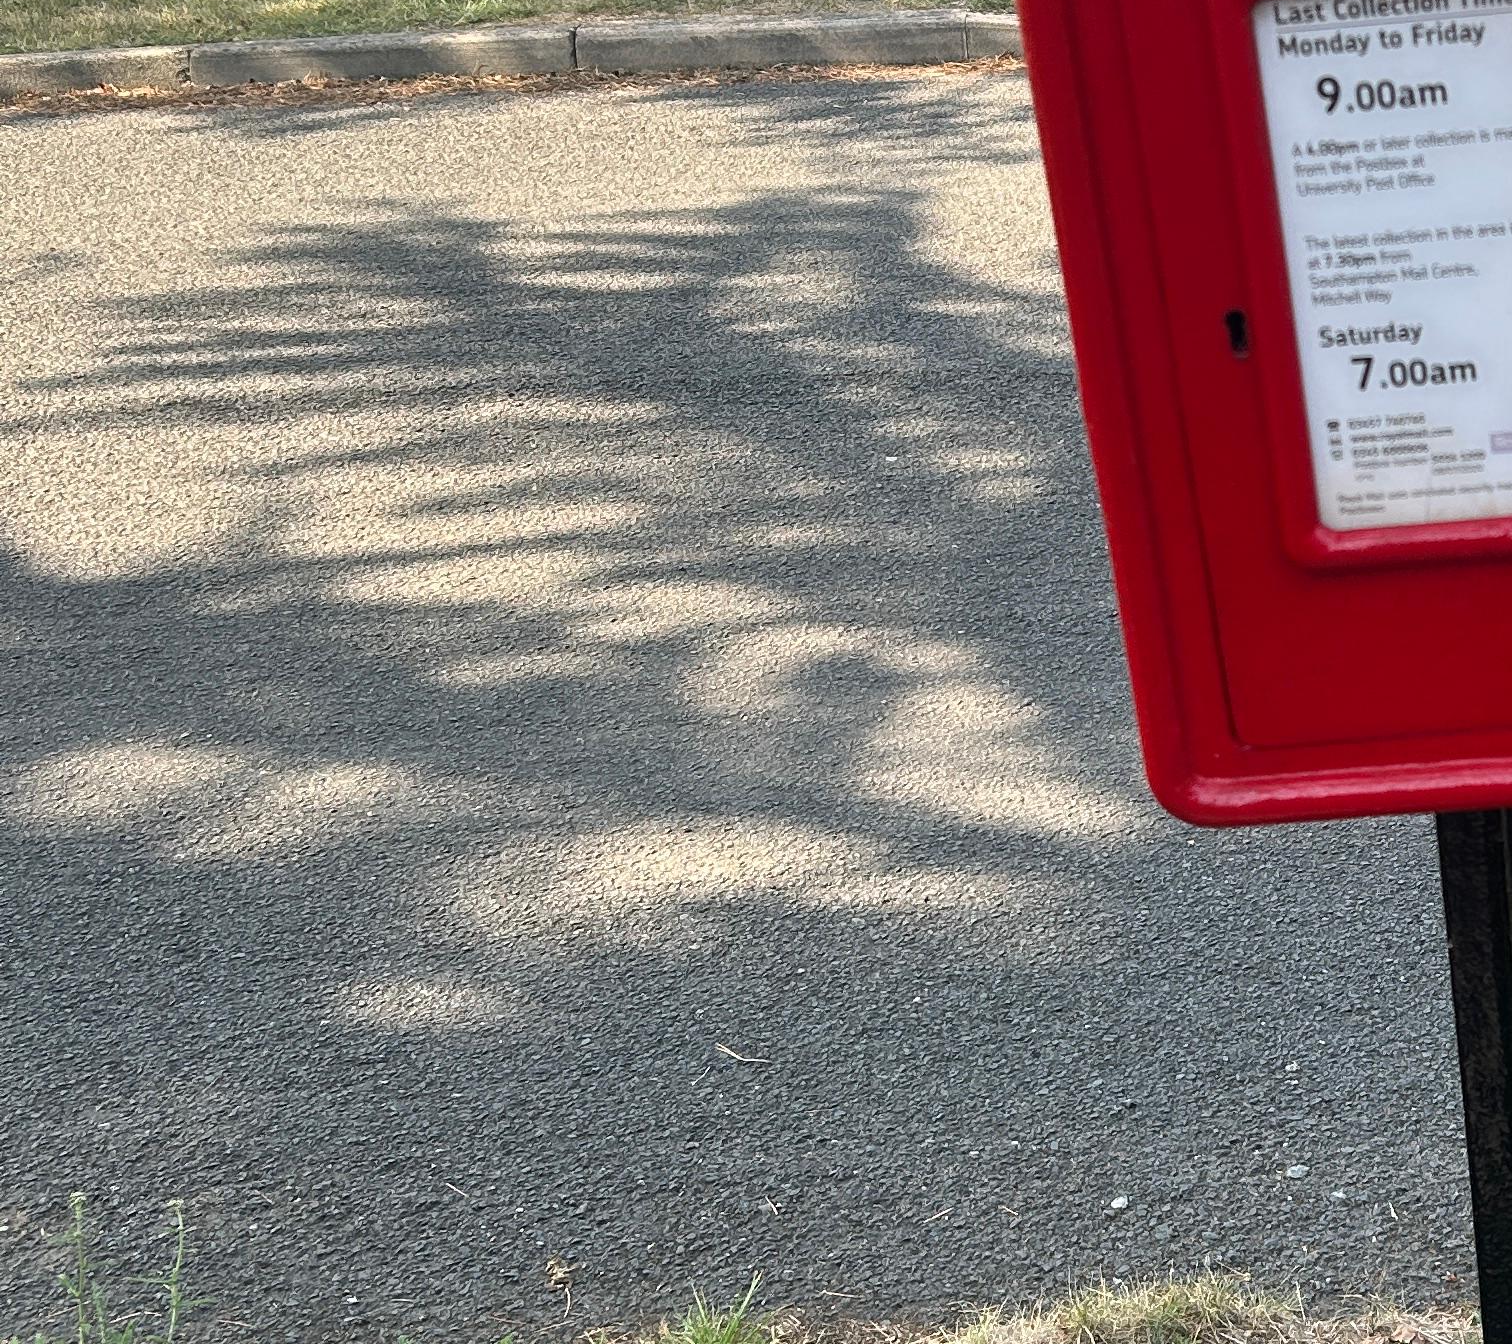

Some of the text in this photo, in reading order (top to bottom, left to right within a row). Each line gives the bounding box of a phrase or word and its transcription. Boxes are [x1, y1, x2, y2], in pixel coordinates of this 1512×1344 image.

[1273, 1, 1326, 26] Last
[1278, 21, 1485, 58] Monday to Friday
[1316, 76, 1448, 114] 9.00am
[1364, 140, 1377, 152] or
[1380, 134, 1411, 151] later
[1414, 129, 1476, 149] collection
[1479, 128, 1490, 143] is
[1294, 154, 1426, 177] from the Postbox at
[1296, 171, 1435, 197] University Post Office
[1305, 235, 1330, 251] The
[1333, 233, 1369, 250] latest
[1373, 228, 1433, 247] collection
[1435, 228, 1448, 242] in
[1451, 225, 1473, 240] the
[1477, 223, 1506, 237] area
[1307, 257, 1322, 271] at
[1379, 249, 1412, 264] from
[1307, 269, 1397, 290] Southampton
[1400, 265, 1428, 281] Mail
[1365, 288, 1392, 305] Way
[1318, 321, 1423, 348] Saturday
[1351, 356, 1477, 391] 7.00am
